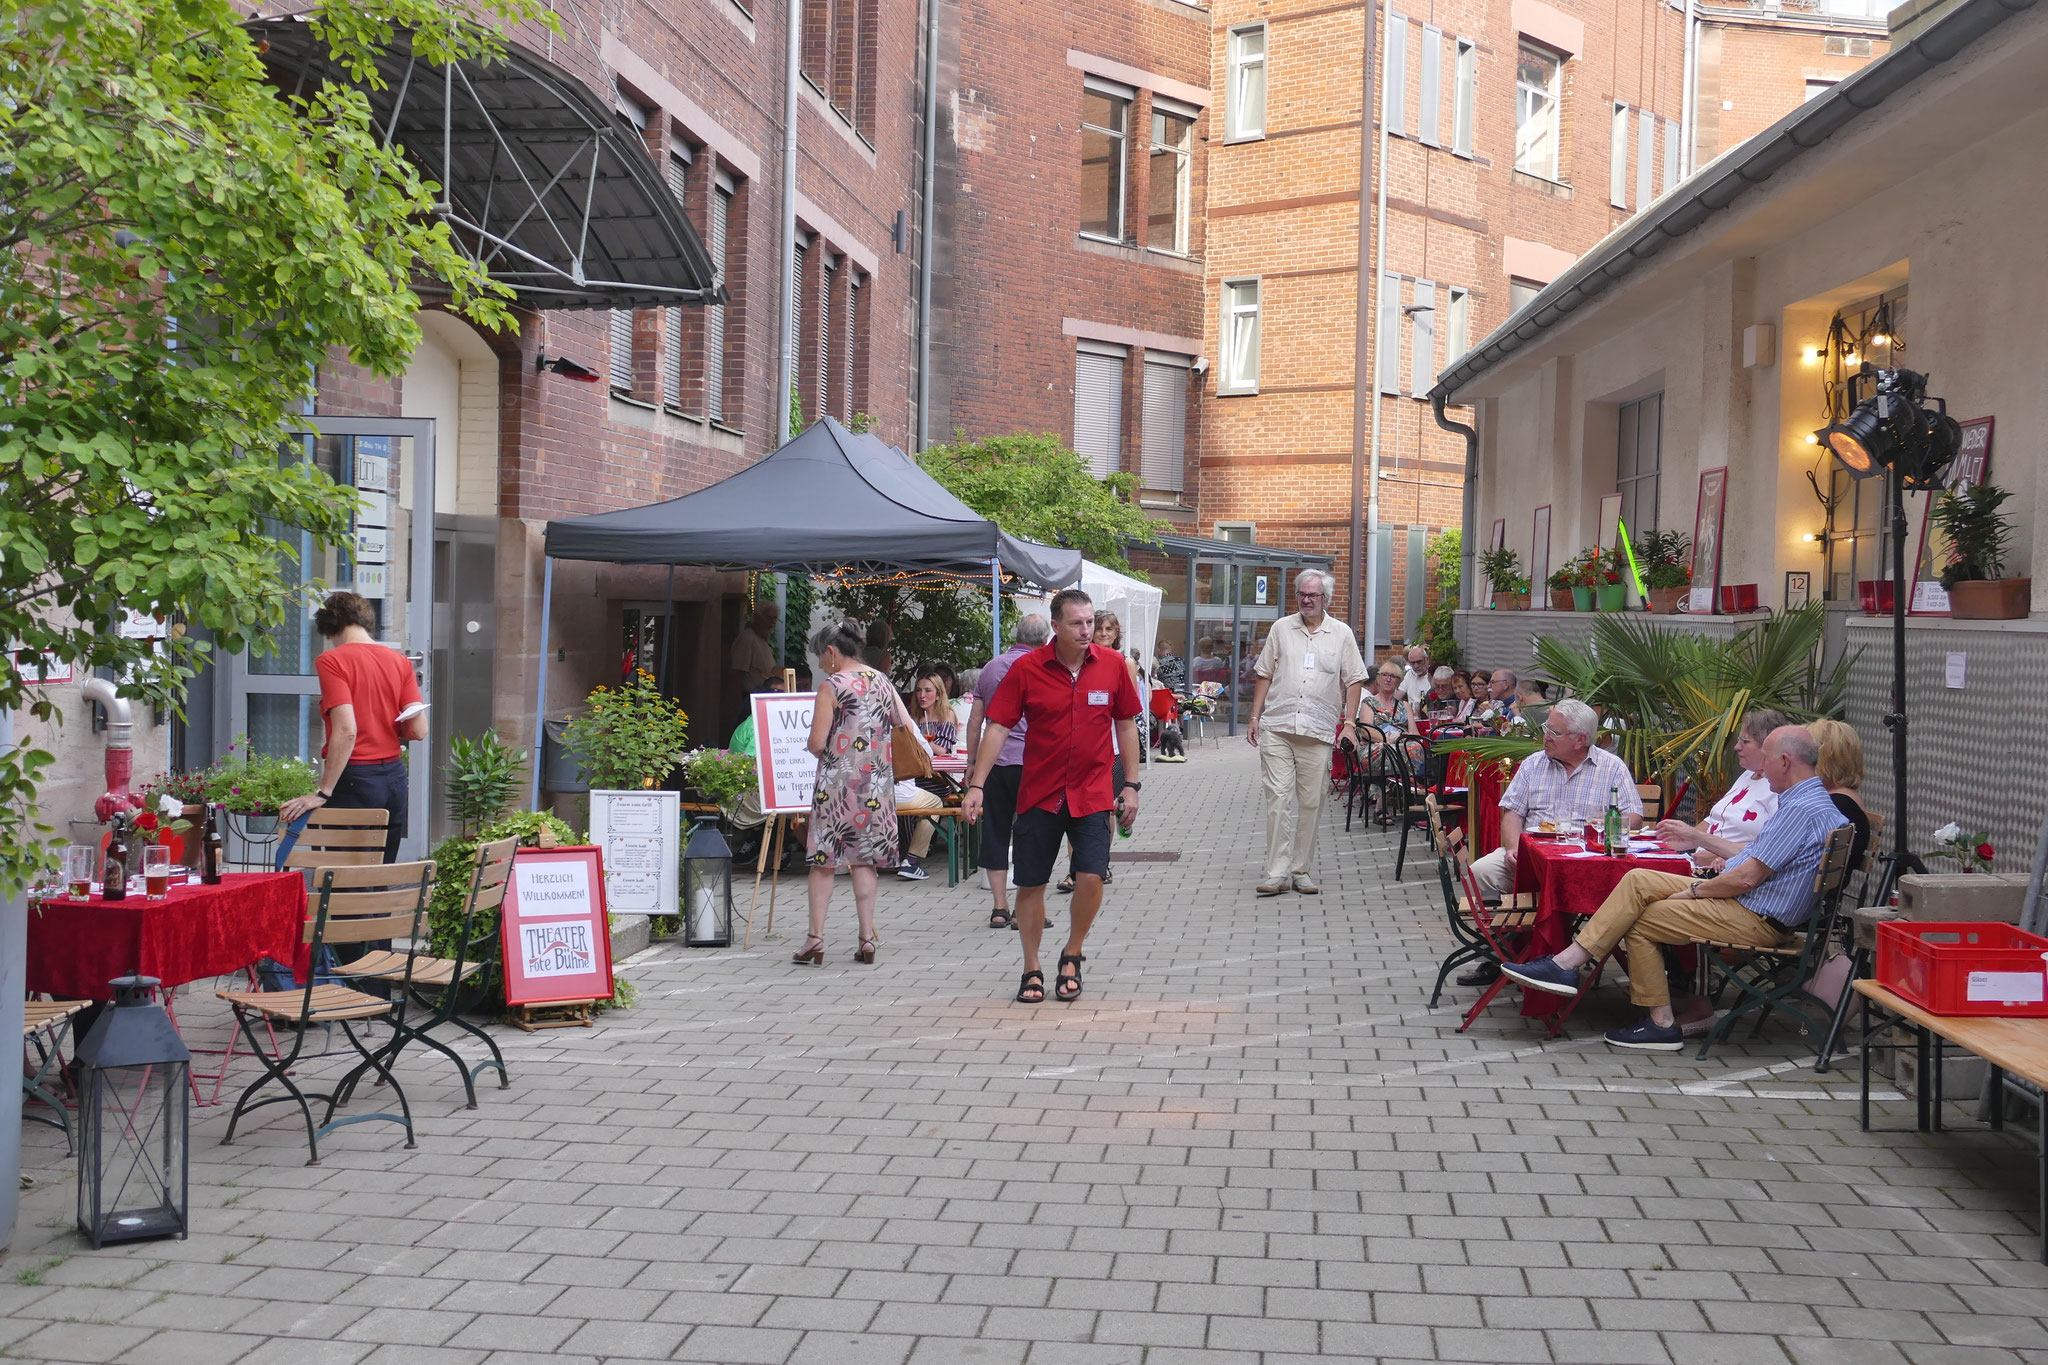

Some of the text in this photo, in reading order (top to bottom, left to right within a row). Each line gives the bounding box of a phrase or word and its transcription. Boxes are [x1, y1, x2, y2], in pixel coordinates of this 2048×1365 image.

[1791, 577, 1805, 590] 12
[778, 710, 812, 730] WC
[776, 770, 816, 779] ODER UNTE
[777, 782, 813, 792] IM THEAT
[531, 873, 574, 884] HERZLICH
[522, 889, 586, 901] WILLKOMMEN!
[526, 925, 588, 959] THEATER
[529, 947, 590, 973] rote Bühne
